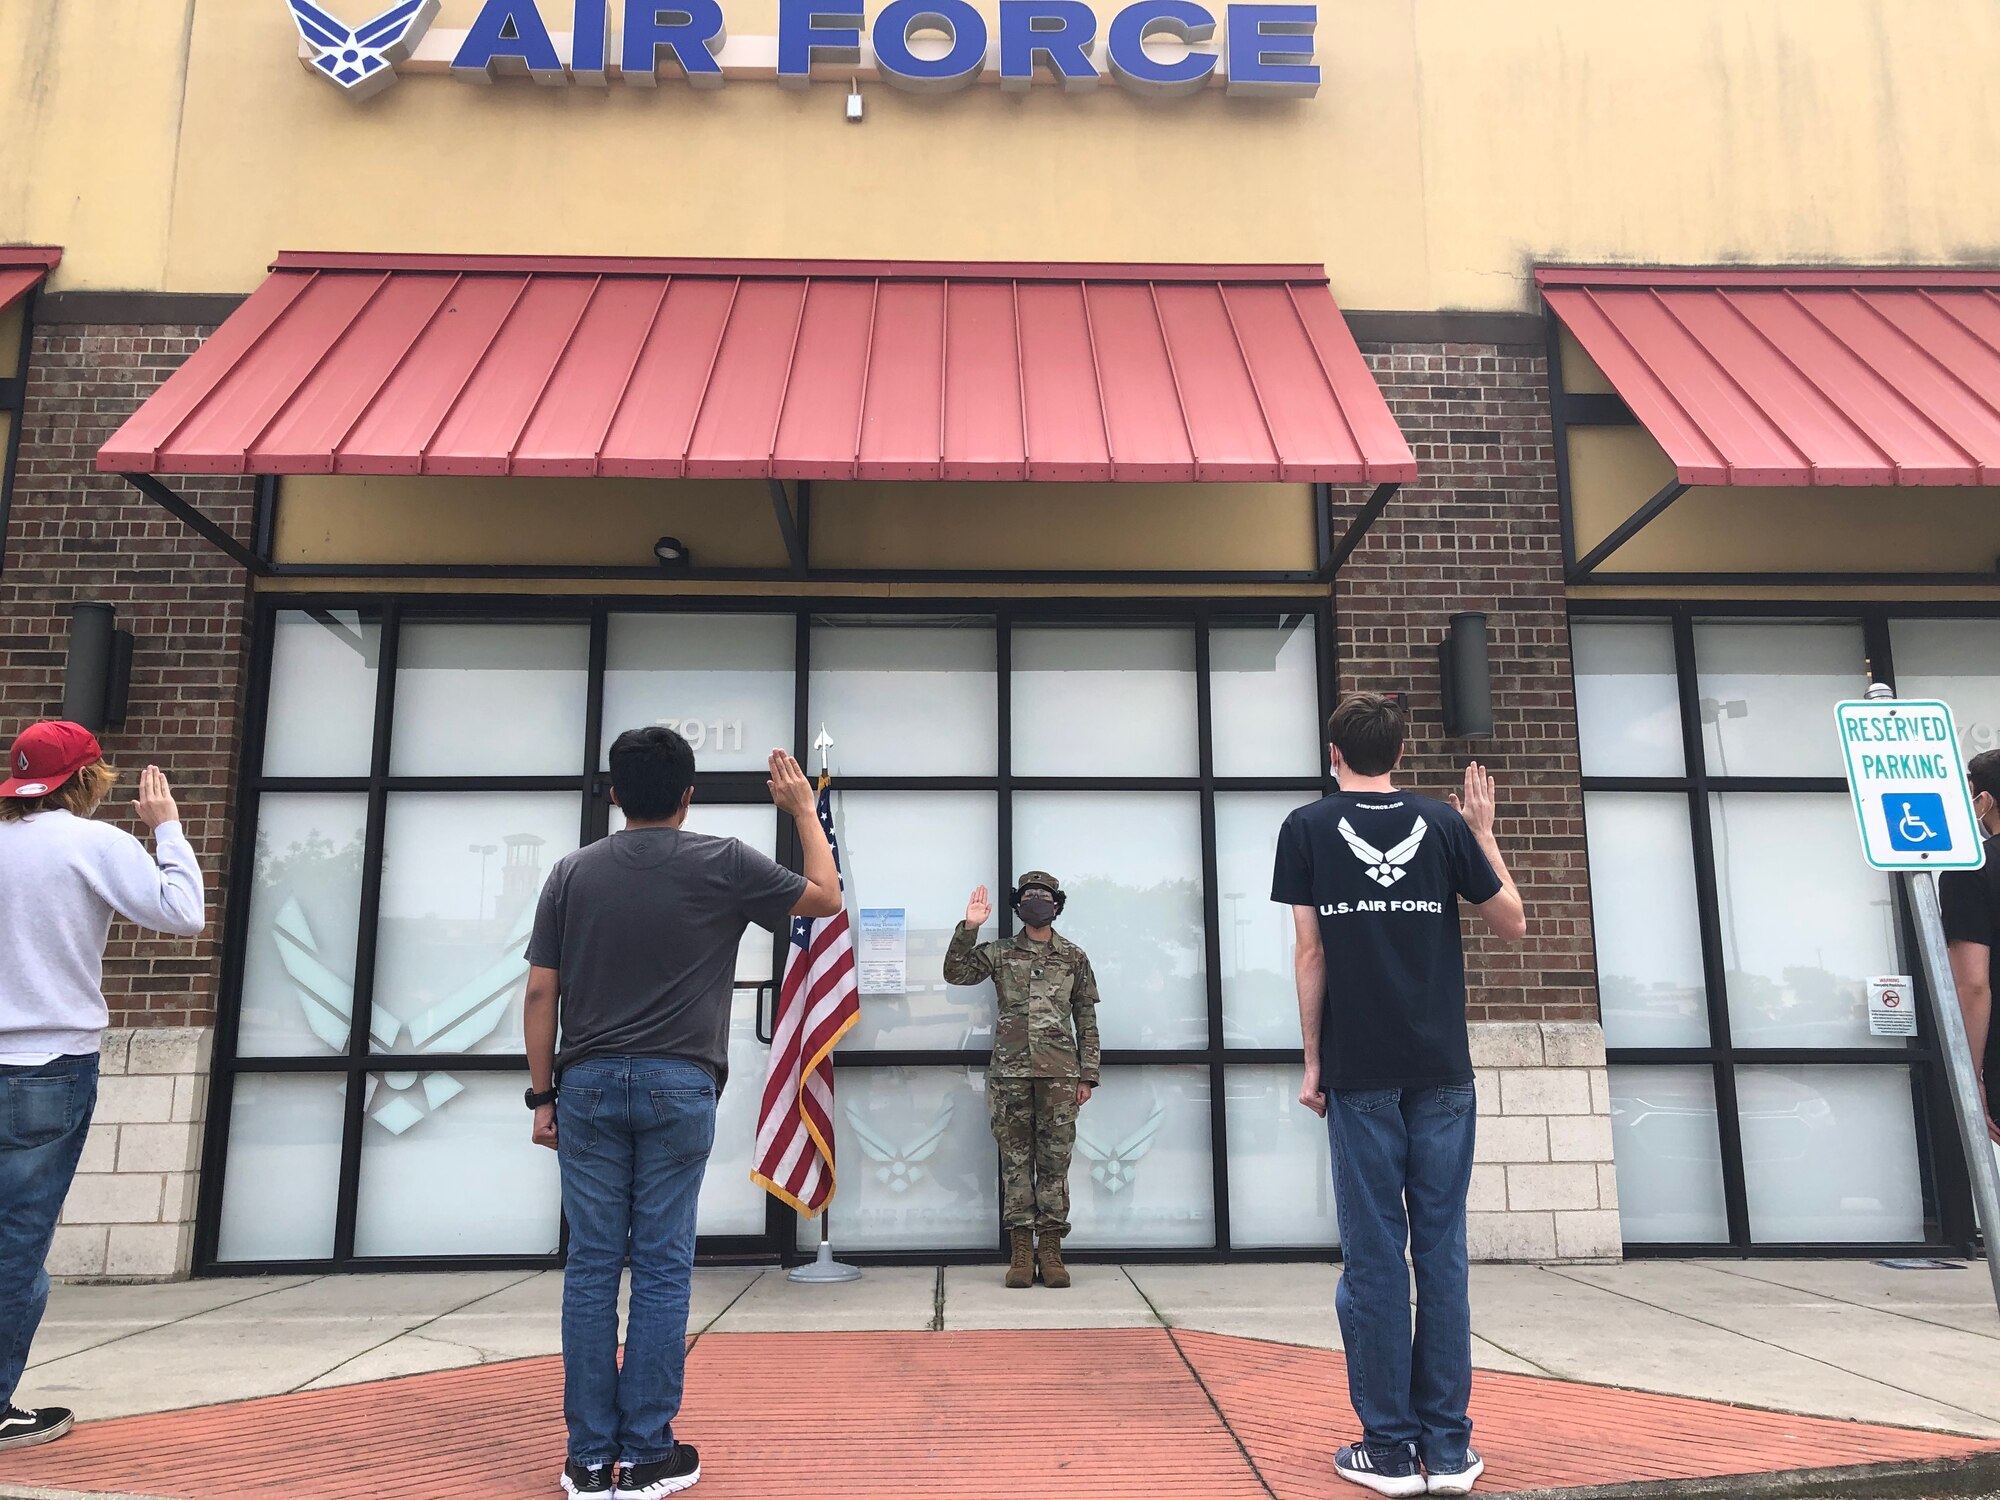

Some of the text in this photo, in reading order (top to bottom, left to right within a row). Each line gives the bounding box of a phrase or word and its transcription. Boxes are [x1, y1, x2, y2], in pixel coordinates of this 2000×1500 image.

[450, 0, 1320, 84] AIR FORCE
[1846, 716, 1946, 741] RESERVED
[1862, 754, 1947, 779] PARKING
[1355, 801, 1404, 811] AIRFORCE.COM
[1319, 902, 1353, 916] U.S.
[1356, 900, 1387, 913] AIR
